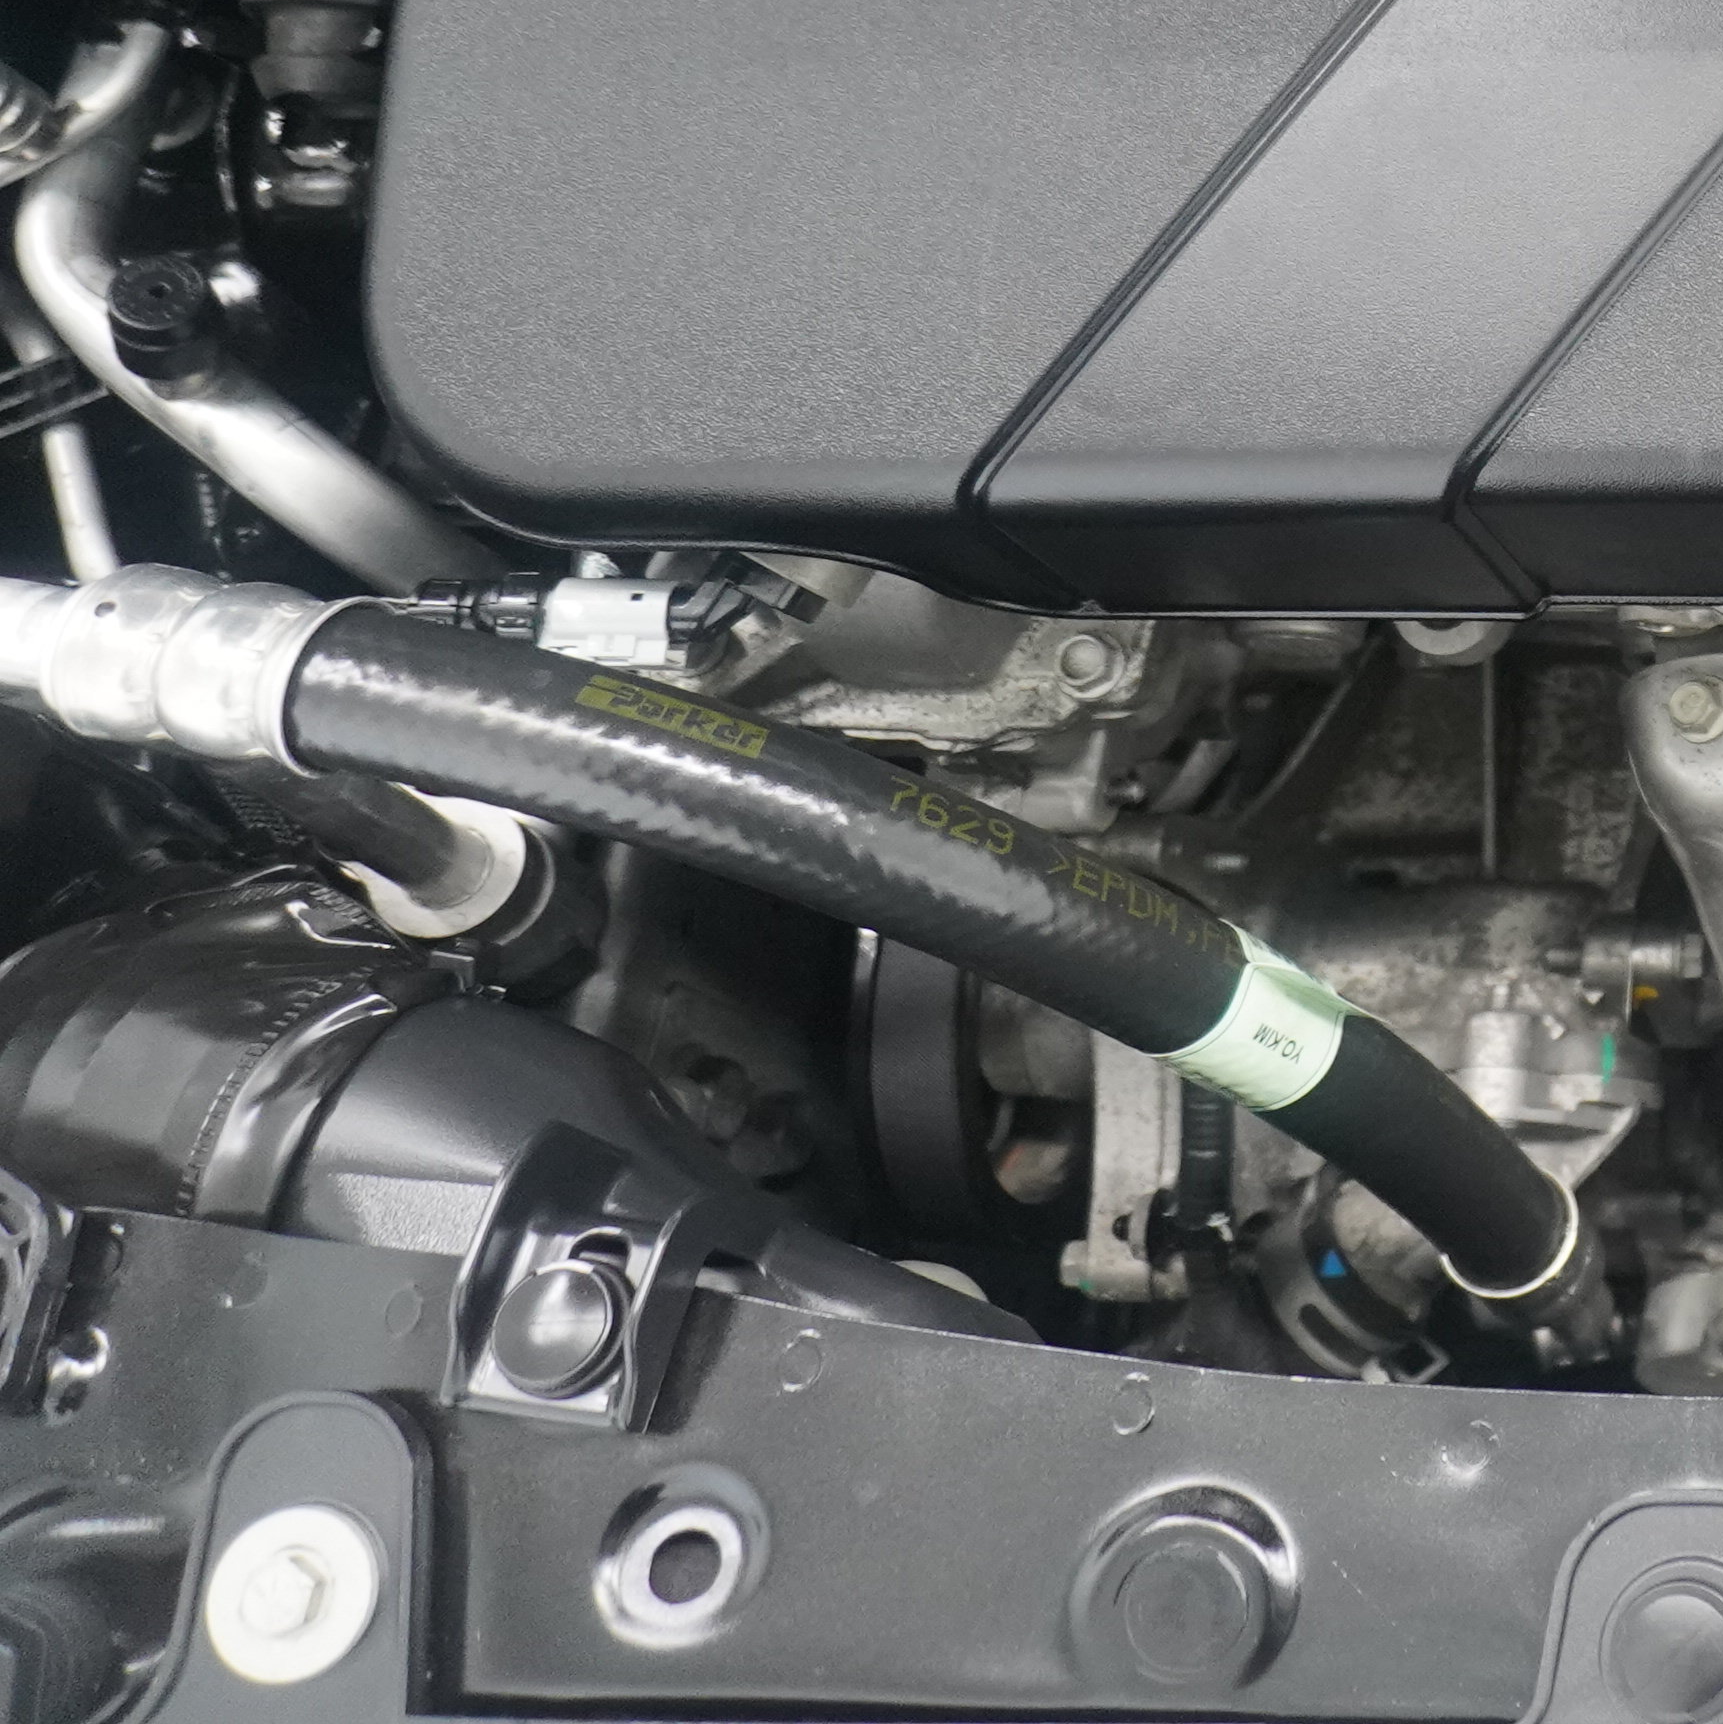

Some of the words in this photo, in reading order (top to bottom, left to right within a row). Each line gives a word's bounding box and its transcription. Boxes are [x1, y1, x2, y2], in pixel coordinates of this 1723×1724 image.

[585, 680, 767, 751] Parker
[889, 774, 1016, 855] 7629
[1253, 1022, 1305, 1065] YO.KIM
